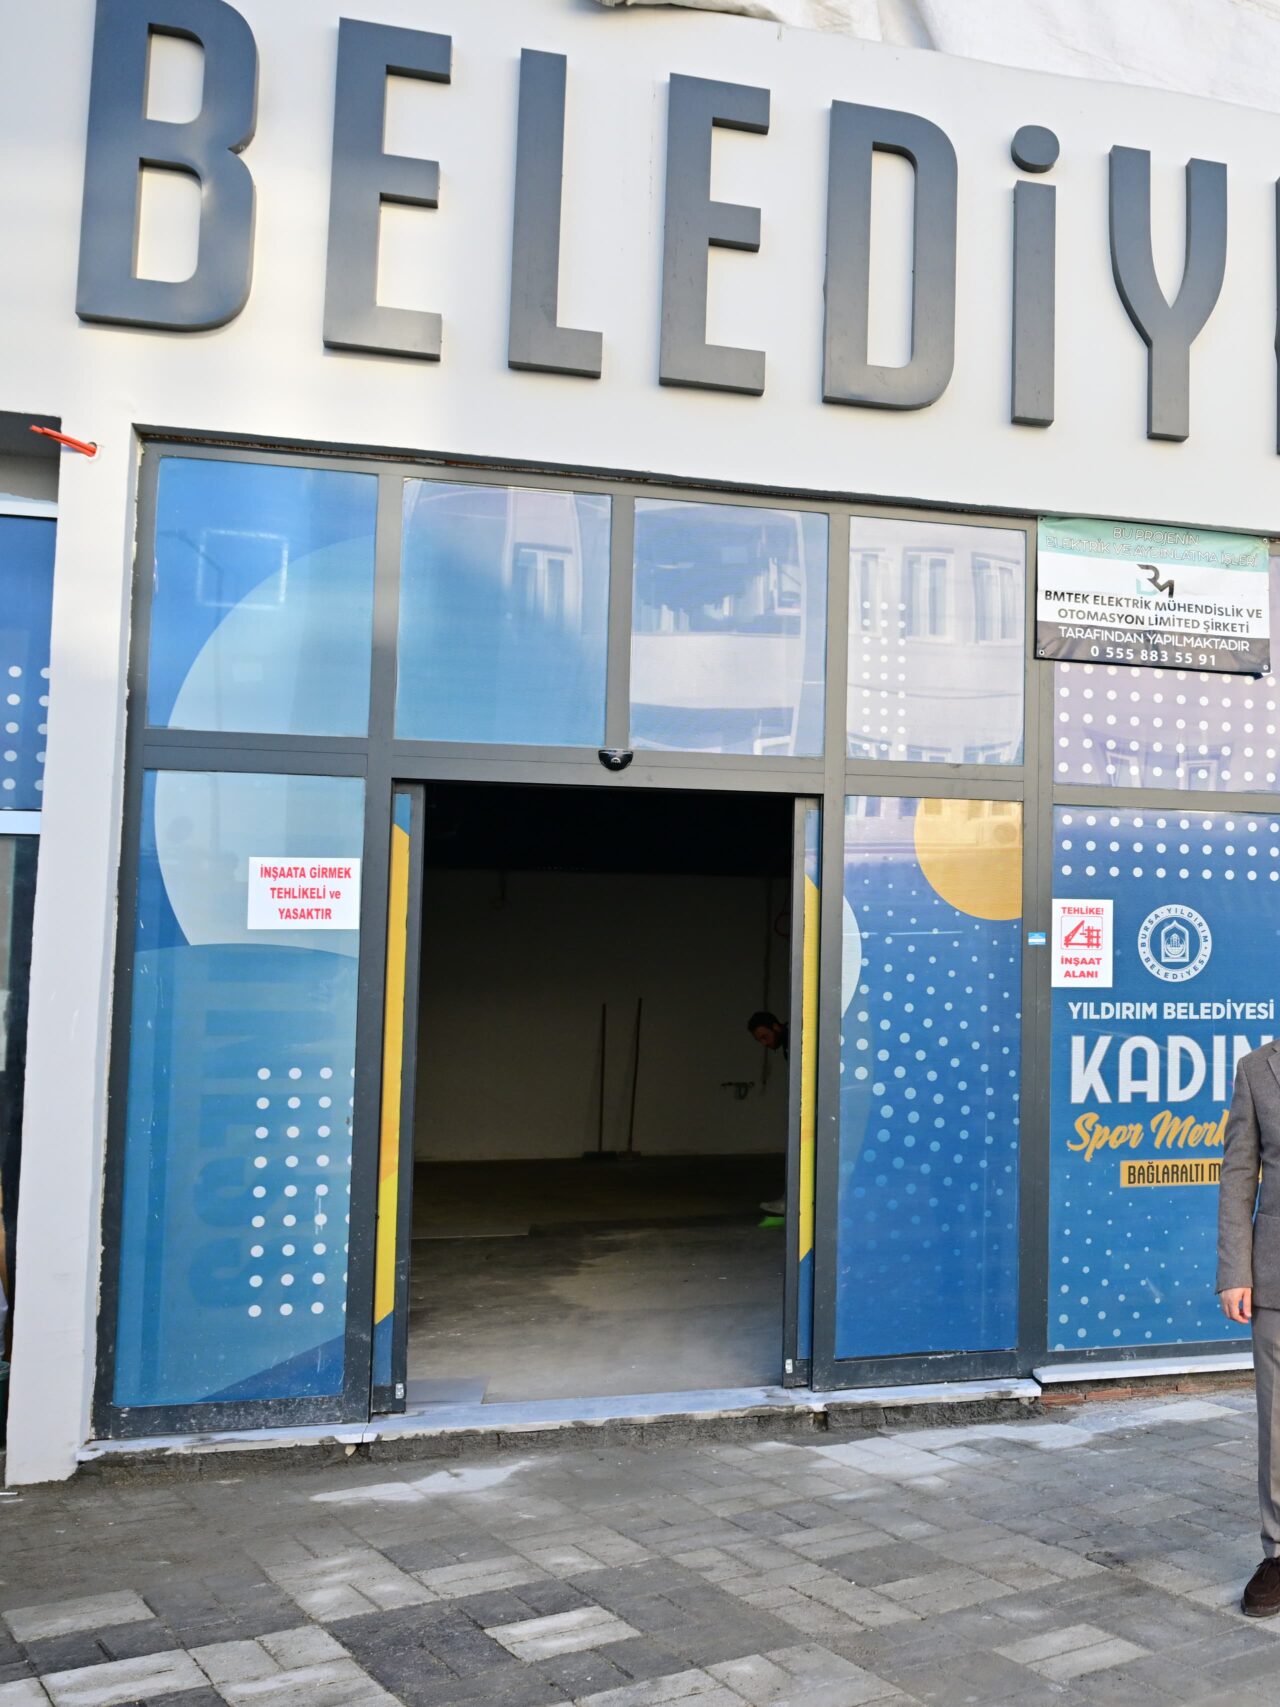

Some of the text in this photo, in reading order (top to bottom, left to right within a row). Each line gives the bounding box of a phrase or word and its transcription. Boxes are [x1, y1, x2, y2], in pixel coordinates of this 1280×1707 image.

[1113, 527, 1133, 540] BU
[1044, 590, 1263, 619] BMTEK ELEKTRİK MÜHENDİSLİK VE
[1057, 608, 1250, 634] OTOMASYON LİMİTED ŞİRKETİ
[1058, 626, 1250, 652] TARAFINDAN YAPILMAKTADIR
[1090, 645, 1216, 666] 0 555 883 55 91
[260, 863, 352, 881] İNŞAATA GİRMEK
[270, 884, 342, 899] TEHLİKELİ ve
[278, 907, 332, 920] YASAKTIR
[1061, 905, 1104, 915] TEHLİKE!
[1141, 913, 1161, 948] BURSA
[1060, 956, 1102, 967] İNŞAAT
[1064, 969, 1099, 979] ALANI
[1068, 998, 1275, 1020] YILDIRIM BELEDİYESİ
[1066, 1112, 1144, 1162] Spor
[1127, 1160, 1204, 1185] BAĞLARALTI
